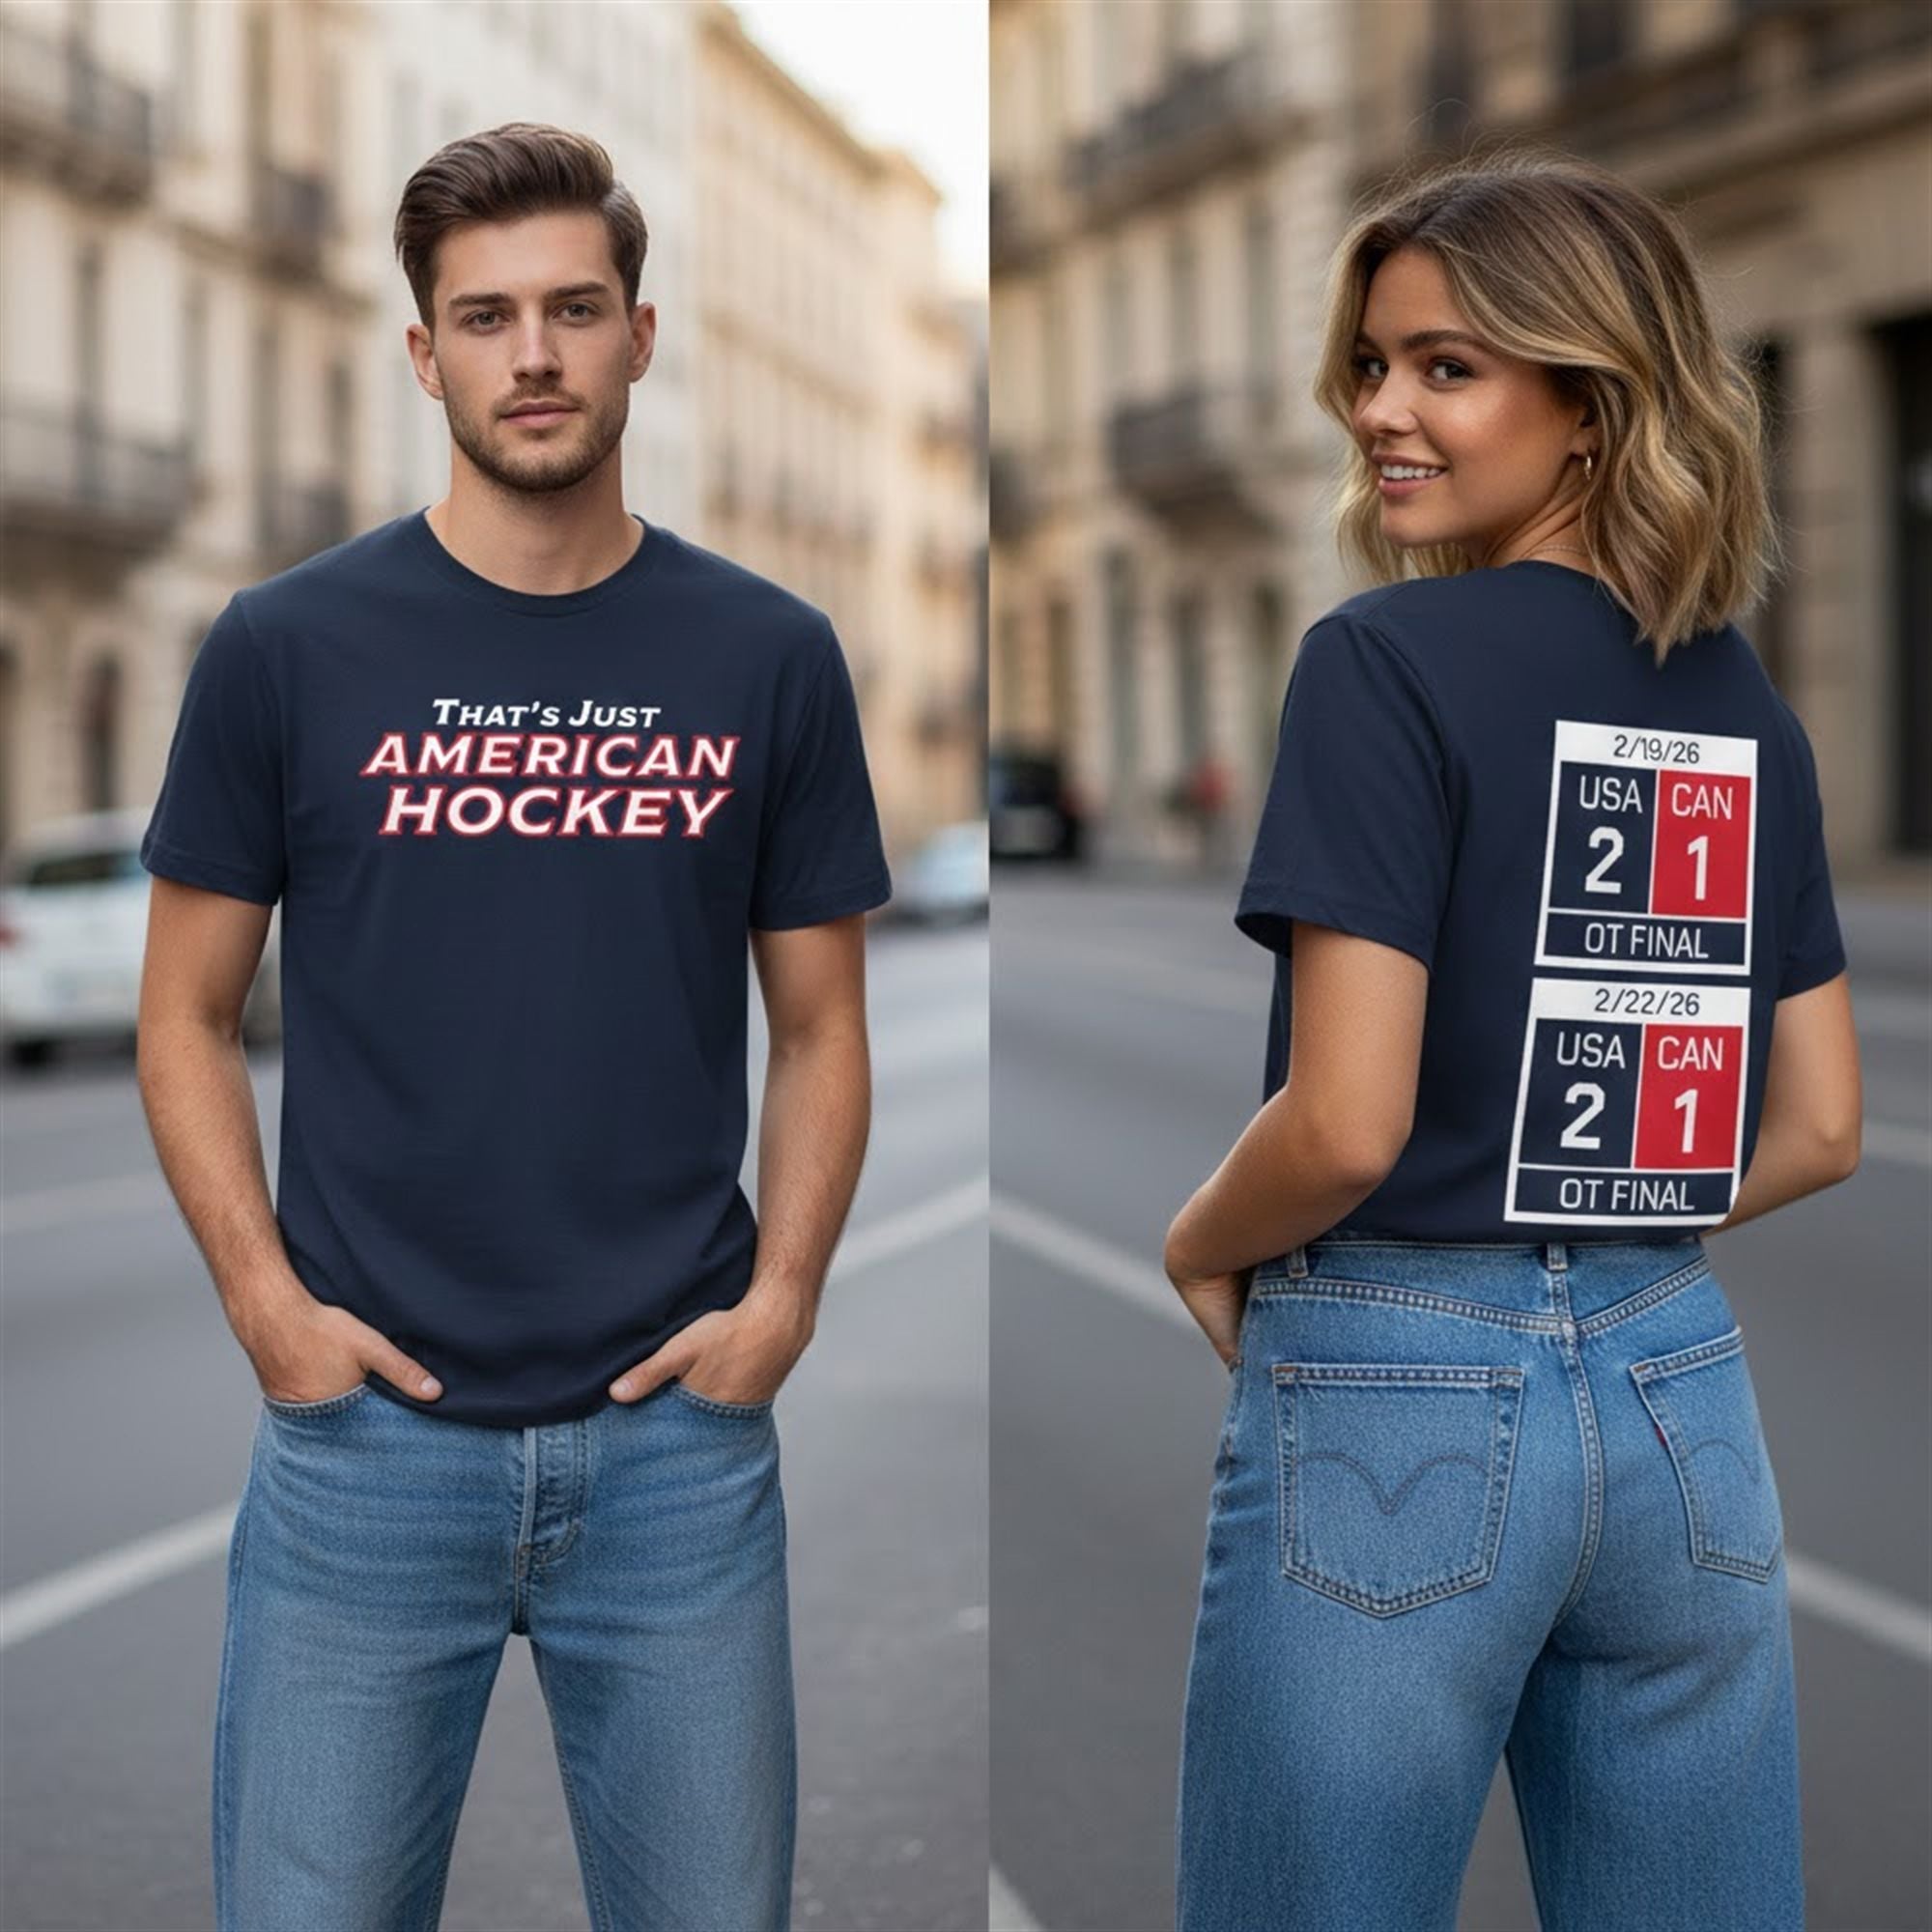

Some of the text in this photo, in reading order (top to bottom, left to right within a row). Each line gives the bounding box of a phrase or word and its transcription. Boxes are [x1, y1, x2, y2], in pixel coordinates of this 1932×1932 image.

[432, 697, 662, 728] THAT'S JUST
[358, 730, 742, 779] AMERICAN
[1613, 733, 1701, 764] 2/19/26
[378, 783, 735, 838] HOCKEY
[1578, 775, 1643, 813] USA
[1671, 782, 1733, 820] CAN
[1584, 826, 1625, 895] 2
[1687, 835, 1709, 901] 1
[1584, 923, 1709, 959] OT FINAL
[1594, 988, 1701, 1016] 2/22/26
[1556, 1031, 1626, 1069] USA
[1657, 1036, 1723, 1071] CAN
[1560, 1081, 1605, 1150] 2
[1674, 1088, 1698, 1153] 1
[1559, 1178, 1695, 1211] OT FINAL
